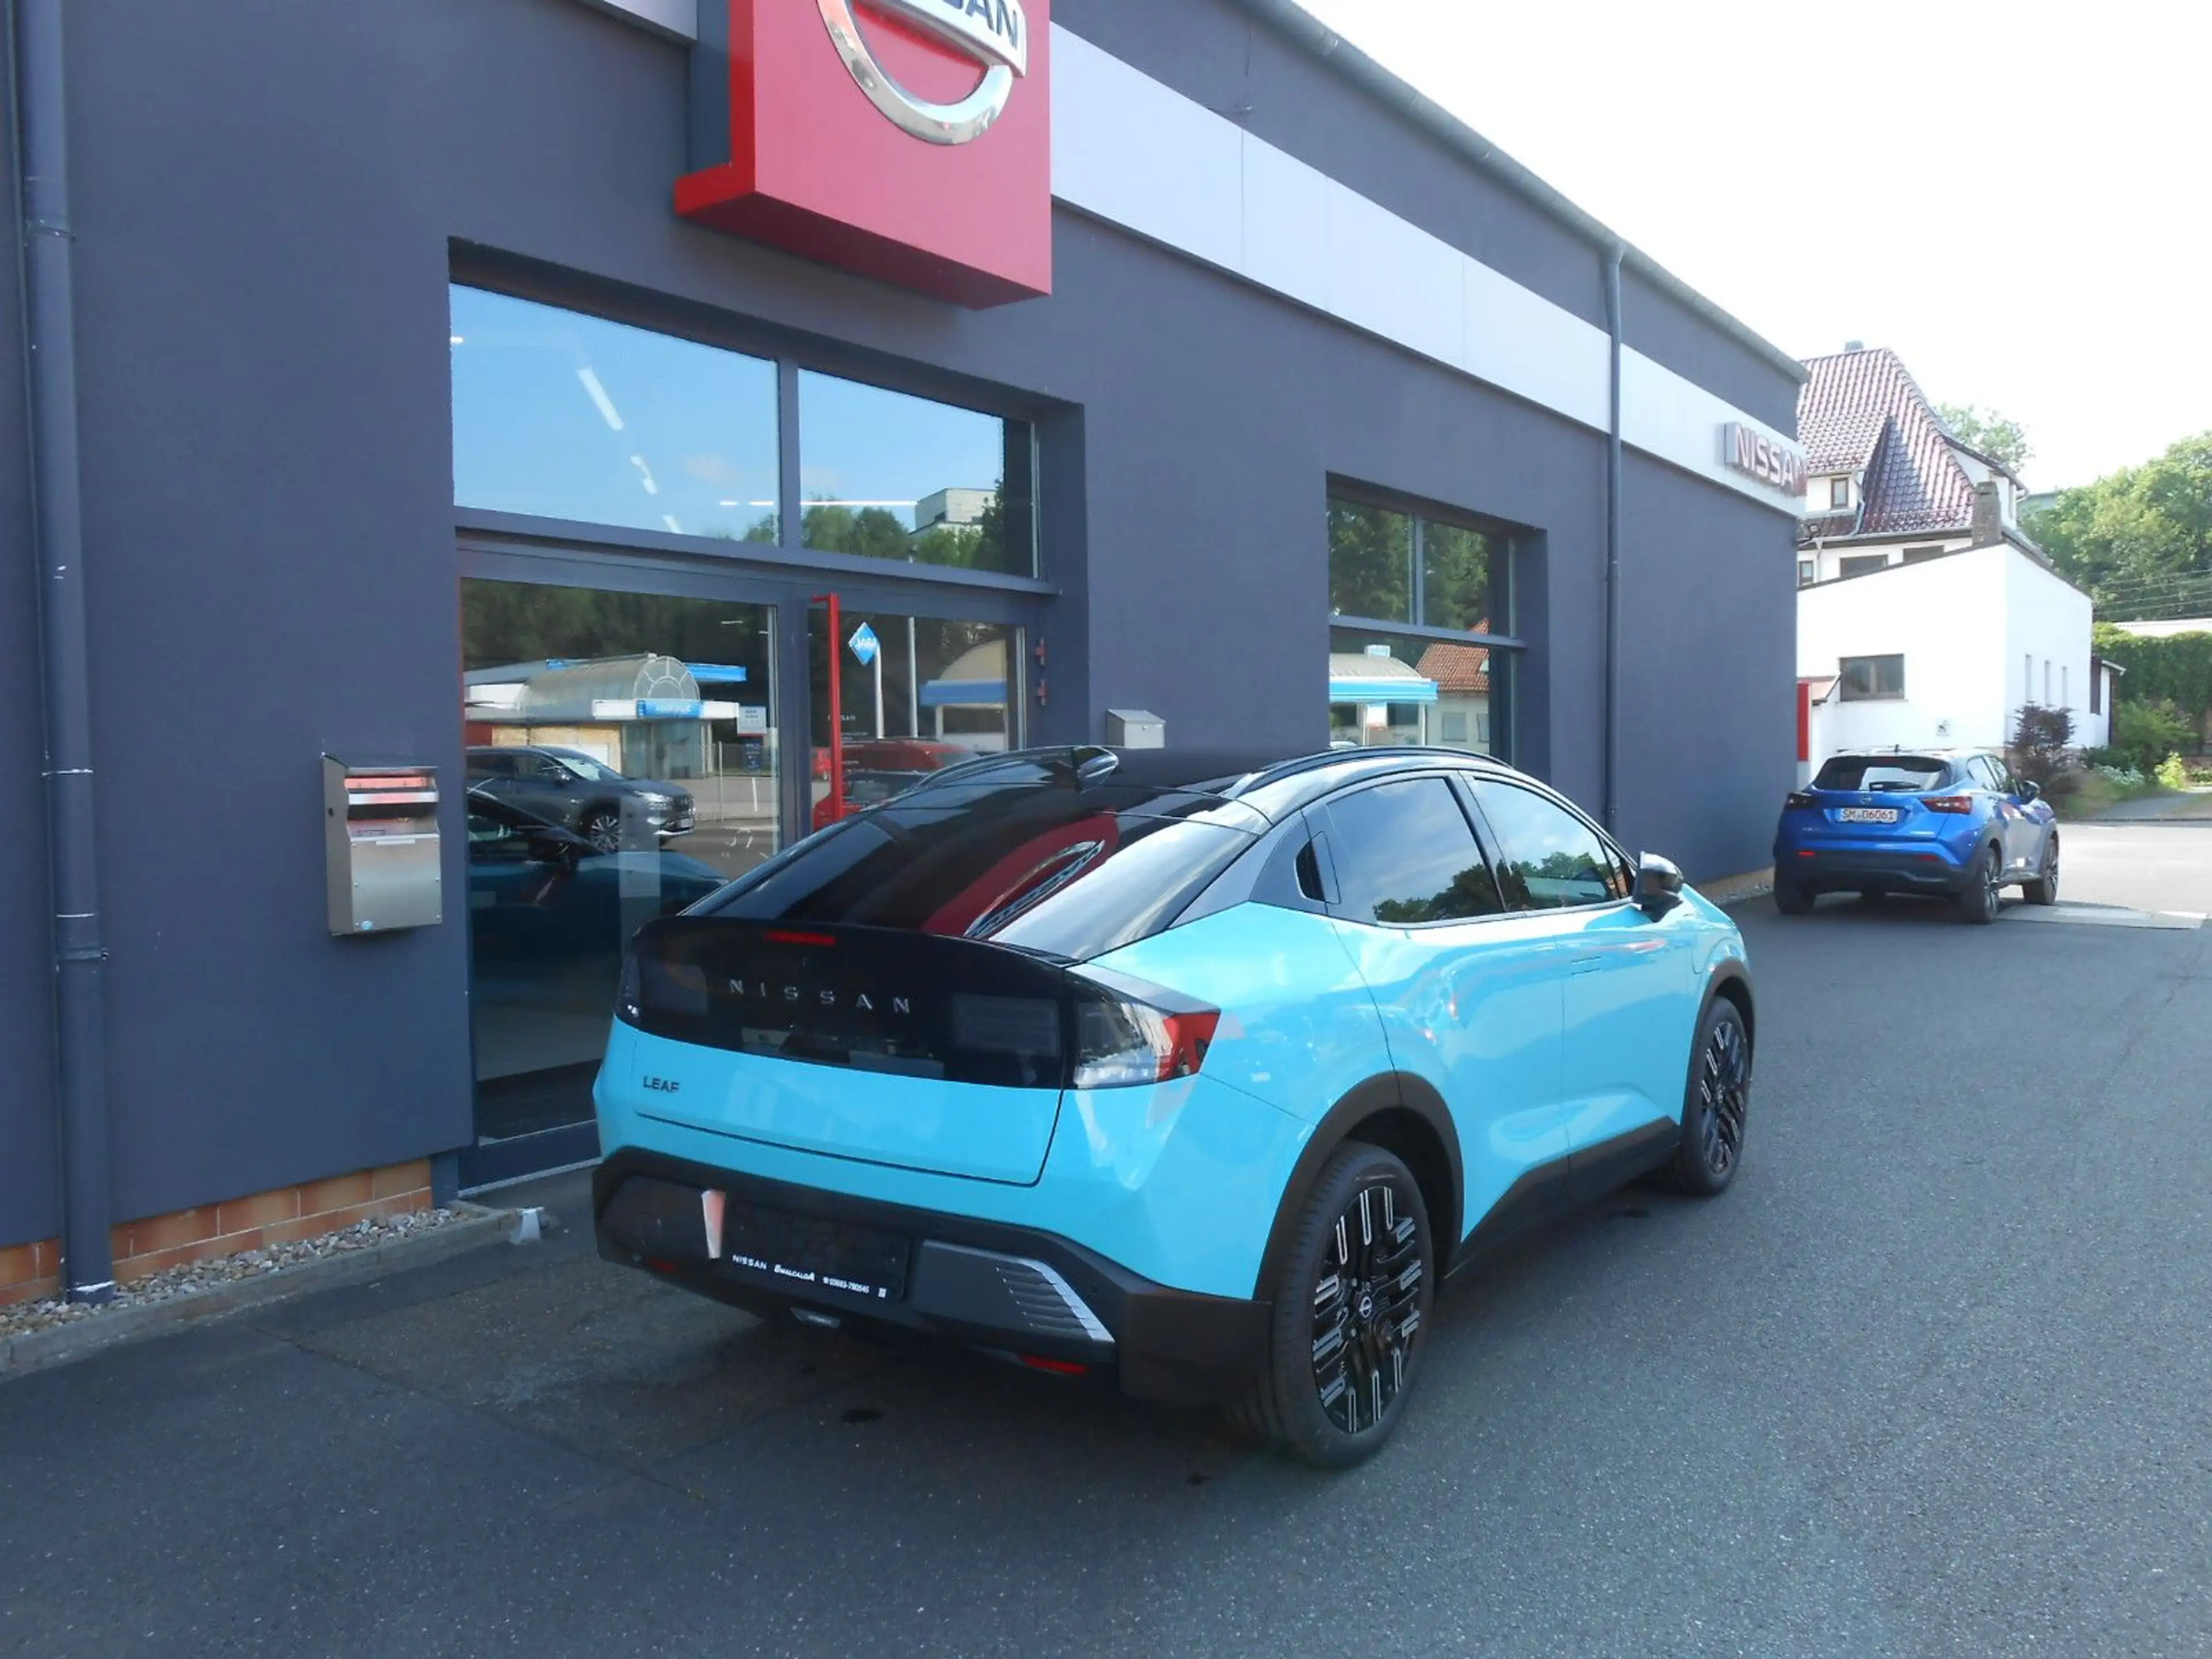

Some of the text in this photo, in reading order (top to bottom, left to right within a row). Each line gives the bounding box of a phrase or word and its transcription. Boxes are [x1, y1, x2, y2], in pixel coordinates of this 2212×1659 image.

[1734, 423, 1808, 492] NISSAN
[729, 979, 910, 1014] NISSAN
[643, 1075, 680, 1093] LEAF
[732, 1254, 767, 1270] NISSAN
